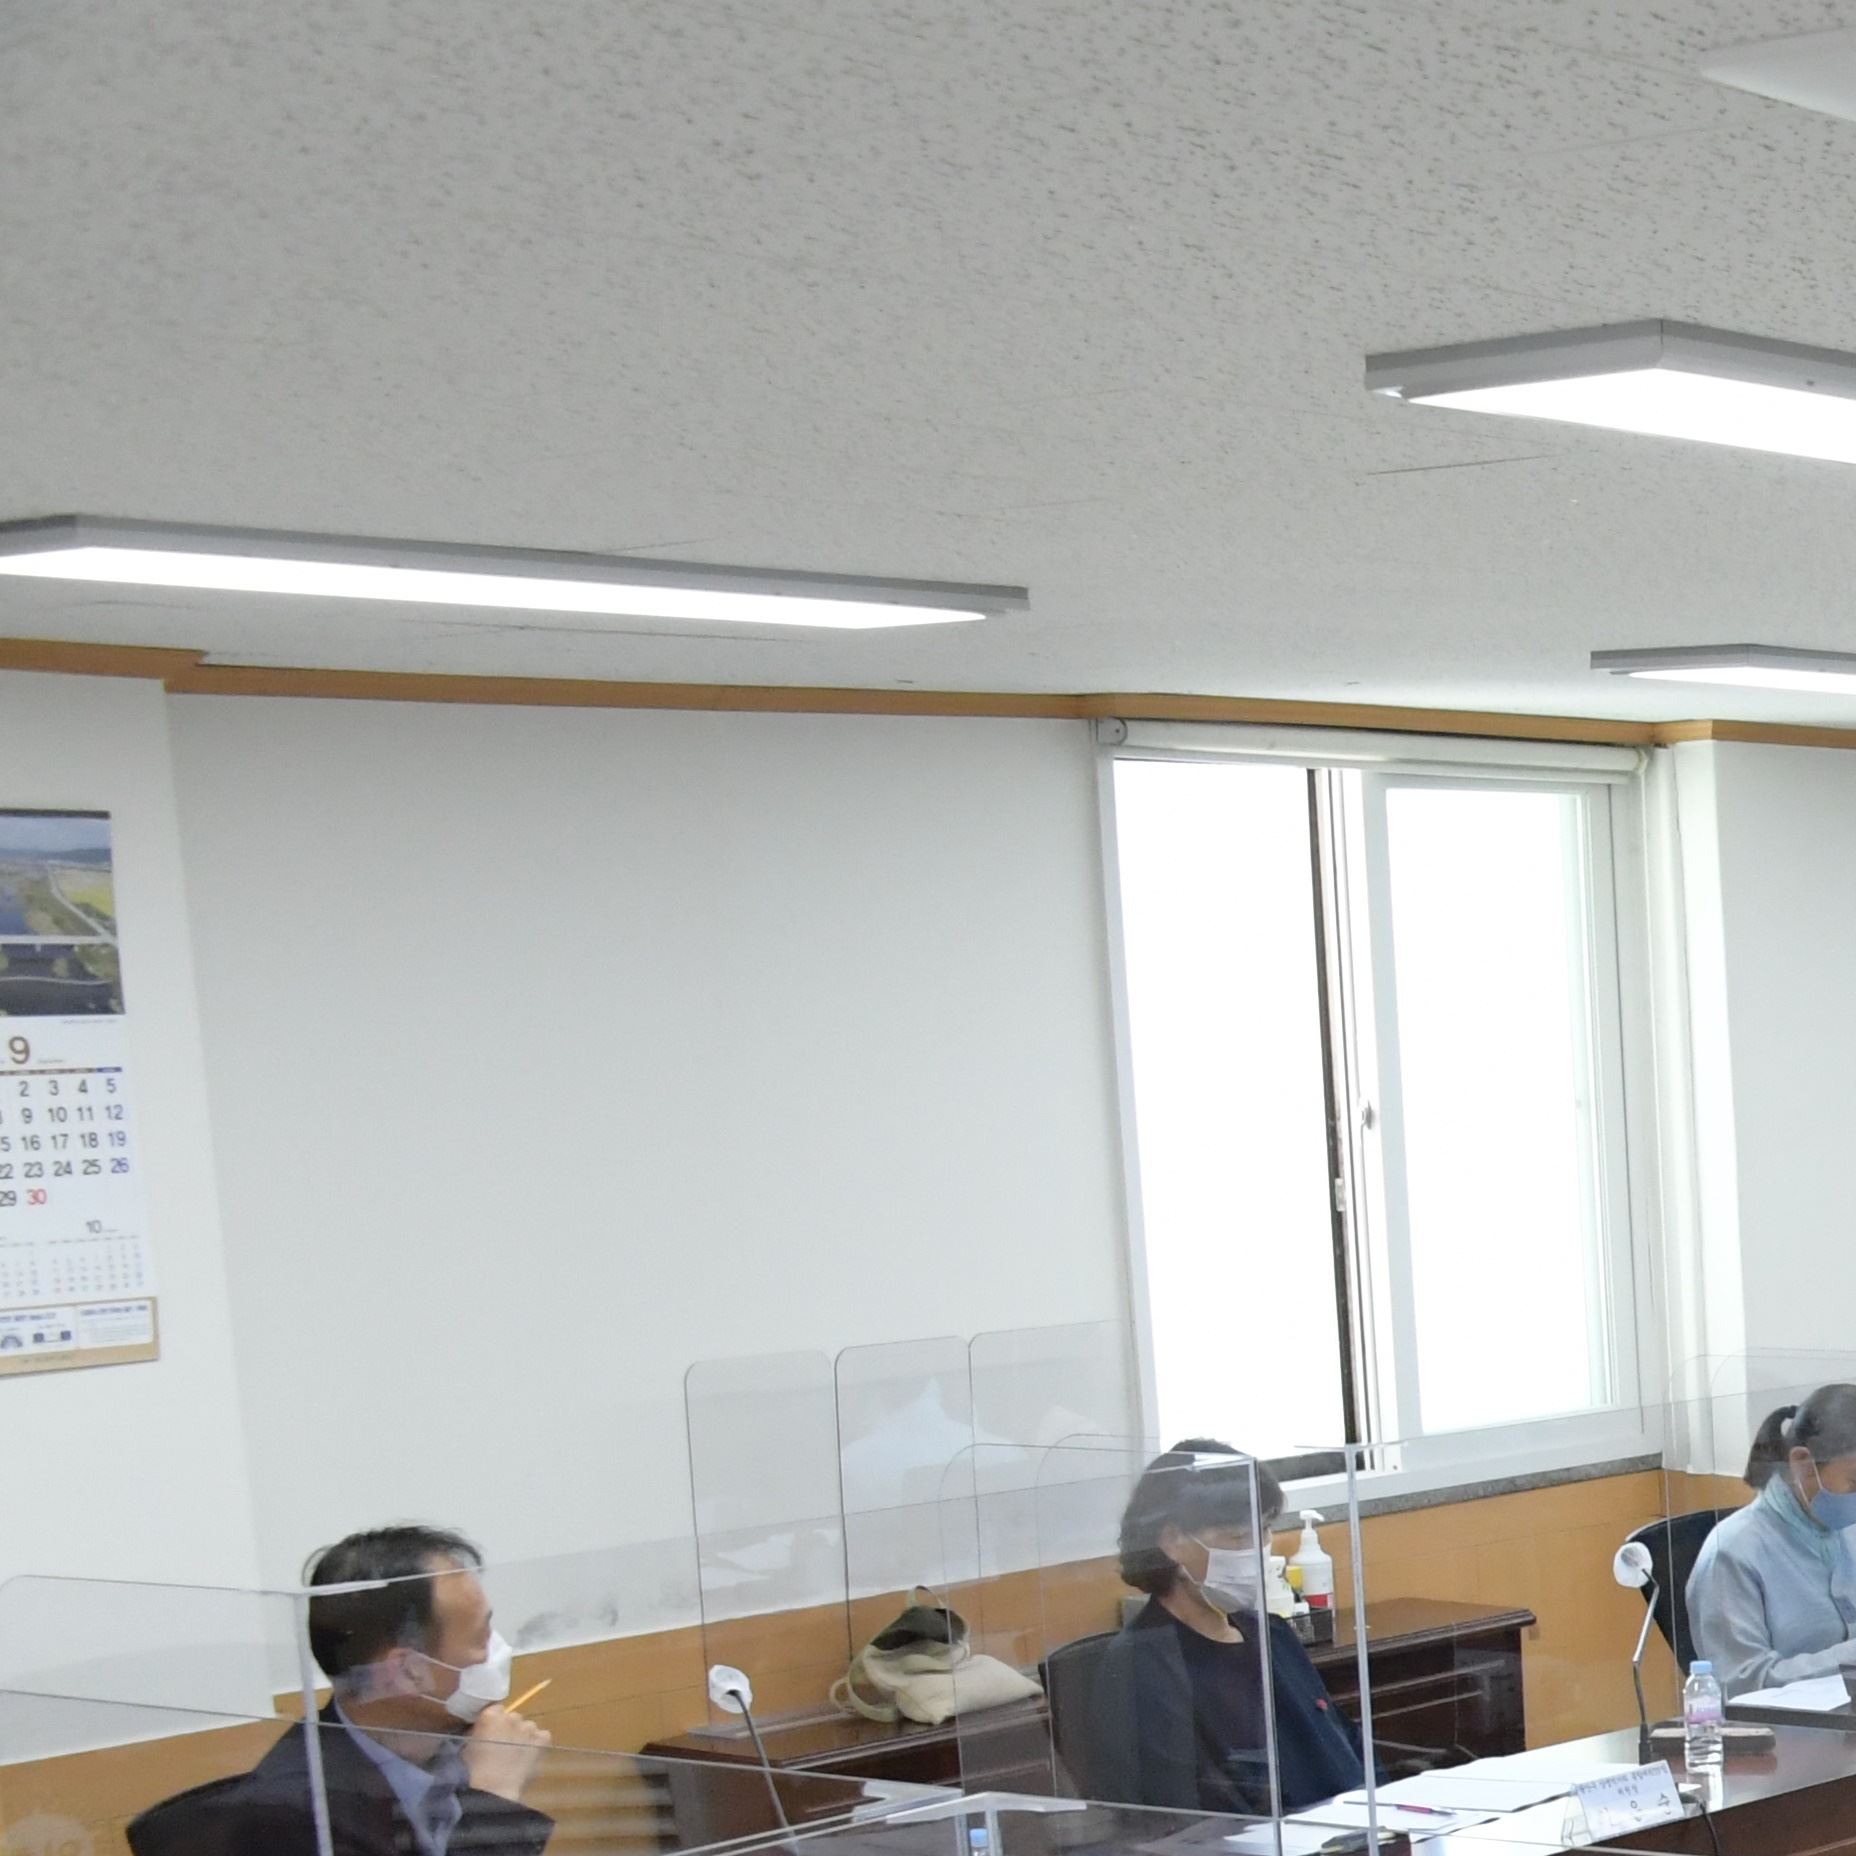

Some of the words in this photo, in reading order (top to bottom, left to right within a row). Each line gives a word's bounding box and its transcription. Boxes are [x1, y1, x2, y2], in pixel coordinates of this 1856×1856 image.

[8, 1036, 31, 1064] 9
[19, 1080, 30, 1097] 2
[48, 1079, 60, 1096] 3
[78, 1079, 89, 1094] 4
[106, 1078, 117, 1094] 5
[21, 1107, 33, 1124] 9
[47, 1106, 68, 1123] 10
[77, 1106, 94, 1121] 11
[105, 1104, 124, 1120] 12
[0, 1136, 11, 1152] 5
[21, 1134, 41, 1151] 16
[51, 1133, 69, 1150] 17
[80, 1132, 99, 1148] 18
[109, 1131, 127, 1147] 19
[24, 1161, 44, 1178] 23
[53, 1160, 73, 1177] 24
[82, 1159, 101, 1176] 25
[110, 1157, 130, 1174] 26
[26, 1188, 48, 1205] 30
